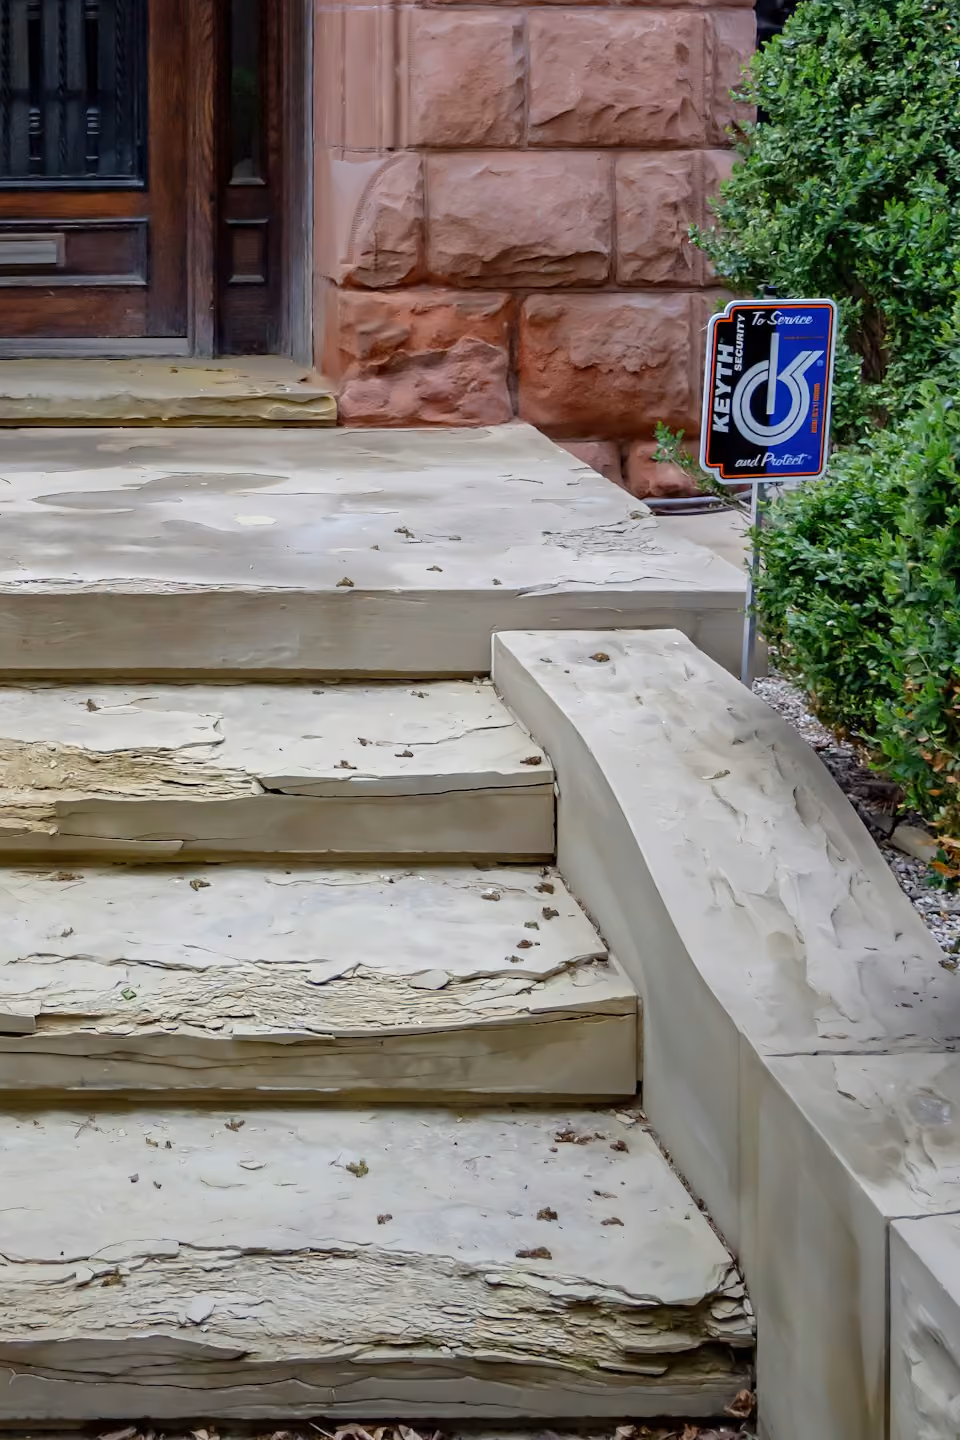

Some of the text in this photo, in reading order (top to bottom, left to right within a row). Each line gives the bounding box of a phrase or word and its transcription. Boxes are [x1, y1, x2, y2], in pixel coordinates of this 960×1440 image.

[751, 310, 813, 325] To Service
[734, 314, 745, 371] SECURITY
[712, 344, 734, 433] KEYTH
[735, 452, 808, 467] and Protect
